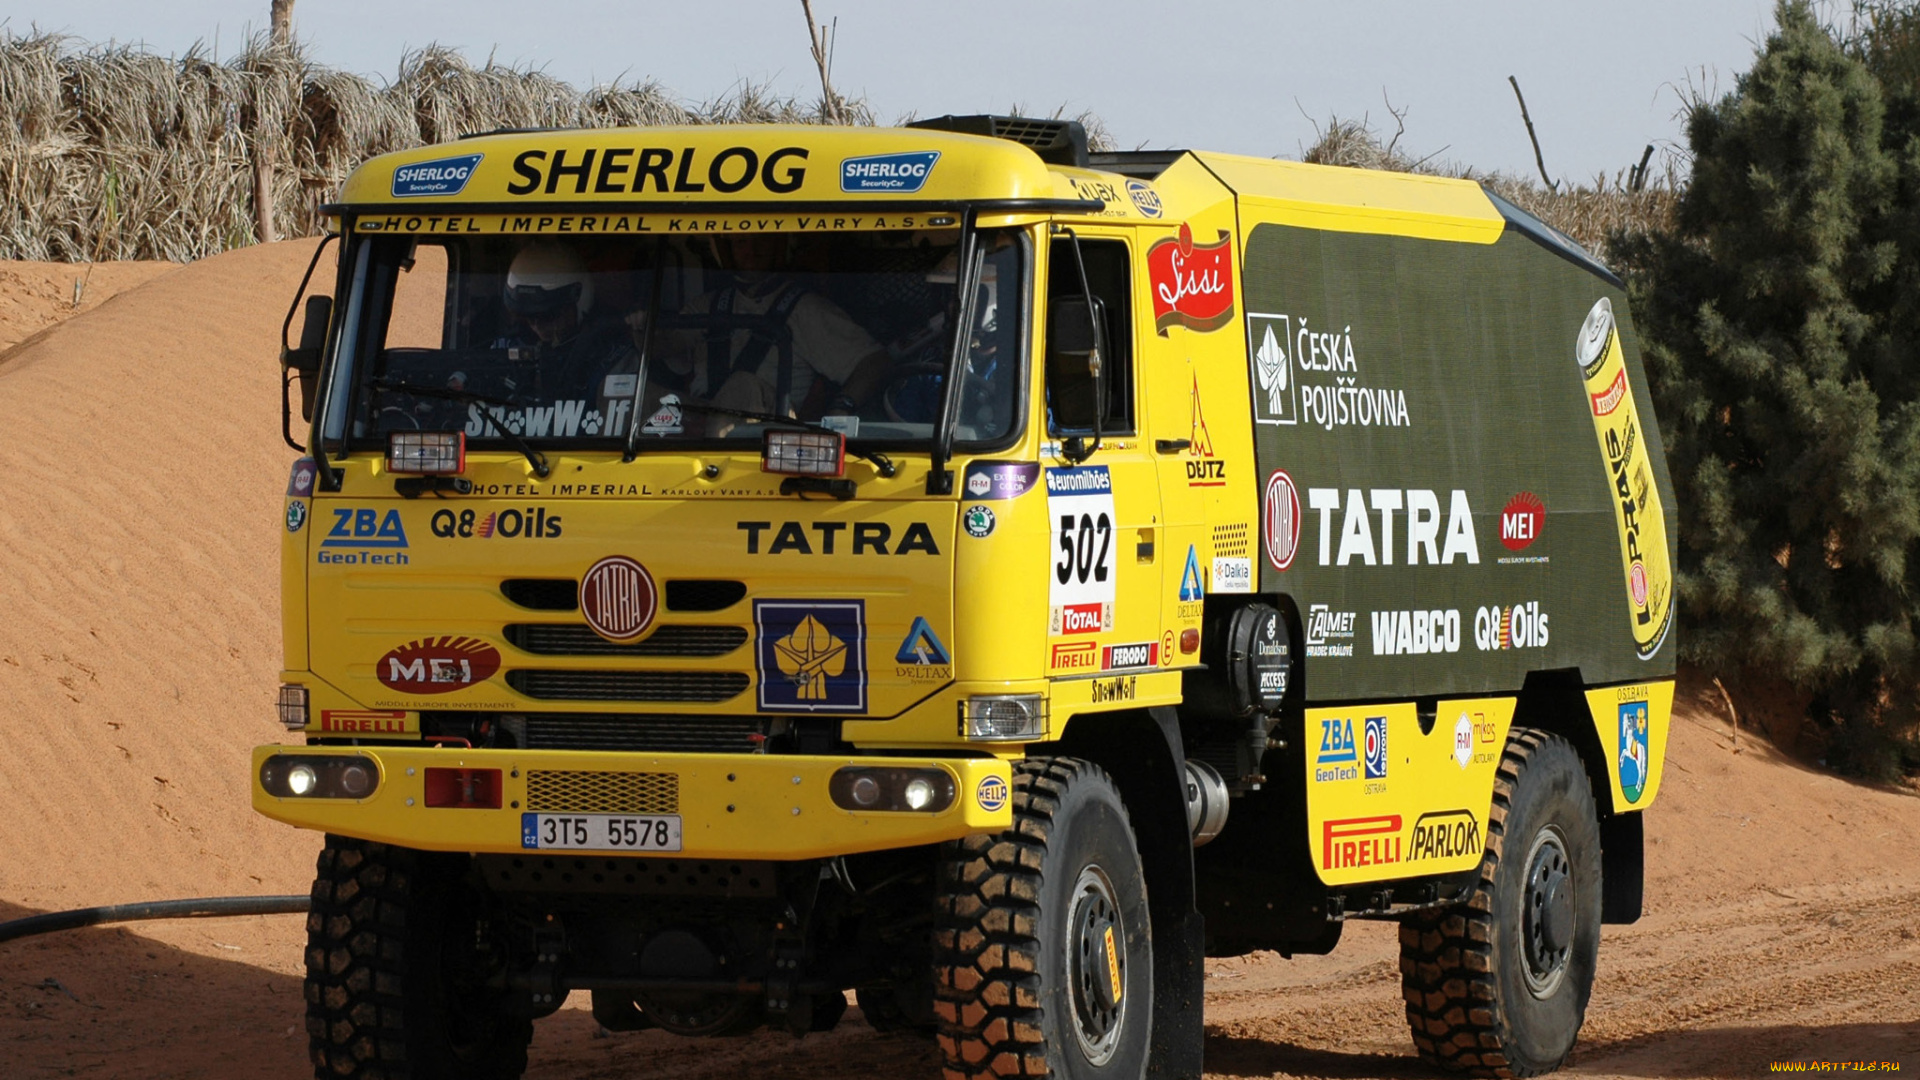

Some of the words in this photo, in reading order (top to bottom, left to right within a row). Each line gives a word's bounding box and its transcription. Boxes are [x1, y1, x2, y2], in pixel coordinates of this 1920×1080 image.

[397, 166, 469, 183] SHERLOG
[507, 147, 810, 195] SHERLOG
[845, 163, 925, 177] SHERLOG
[409, 182, 449, 192] SecurityCar
[861, 180, 905, 189] SecurityCar
[1131, 190, 1161, 208] HELLA
[384, 217, 481, 232] HOTEL
[500, 217, 652, 231] IMPERIAL
[669, 218, 785, 231] KARLOVY
[797, 217, 863, 229] VARY
[875, 216, 924, 228] A.S.
[1159, 249, 1225, 311] Sissi
[1297, 317, 1358, 372] ČESKÁ
[1301, 377, 1411, 430] POJIŠŤOVNA
[993, 474, 1027, 483] EXTREME
[1186, 460, 1226, 478] DEUTZ
[473, 484, 539, 496] HOTEL
[552, 484, 652, 496] IMPERIAL
[661, 488, 716, 496] KARLOVY
[721, 488, 752, 496] VARY
[971, 479, 988, 489] R-M
[999, 483, 1024, 492] COLOR
[1055, 470, 1110, 490] euromilhões
[325, 509, 407, 541] ZBA
[430, 508, 476, 538] Q8
[496, 507, 562, 539] Oils
[1269, 479, 1293, 561] TATRA
[1308, 488, 1480, 566] TATRA
[1502, 512, 1534, 539] MEI
[737, 521, 941, 555] TATRA
[317, 551, 409, 565] GeoTech
[1057, 512, 1111, 585] 502
[1224, 563, 1249, 578] Dalkia
[593, 564, 641, 631] TATRA
[1064, 608, 1101, 630] TOTAL
[1475, 606, 1501, 651] Q8
[1510, 601, 1549, 649] Oils
[1371, 609, 1460, 655] WABCO
[1051, 641, 1097, 669] PIRELLI
[1112, 646, 1147, 666] FERODO
[1258, 640, 1288, 656] Donaldson
[389, 657, 472, 683] MEI
[895, 667, 951, 679] DELTAX
[1617, 686, 1649, 701] OSTRAVA
[375, 700, 410, 708] MIDDLE
[452, 701, 516, 709] INVESTMENTS
[321, 709, 406, 733] PIRELLI
[1318, 719, 1356, 756] ZBA
[1456, 732, 1471, 750] R-M
[1315, 766, 1358, 782] GeoTech
[979, 785, 1008, 801] HELLA
[524, 836, 536, 845] CZ
[543, 818, 588, 845] 3T5
[608, 819, 669, 846] 5578
[1323, 814, 1402, 870] PIRELLI
[1412, 821, 1480, 862] PARLOK
